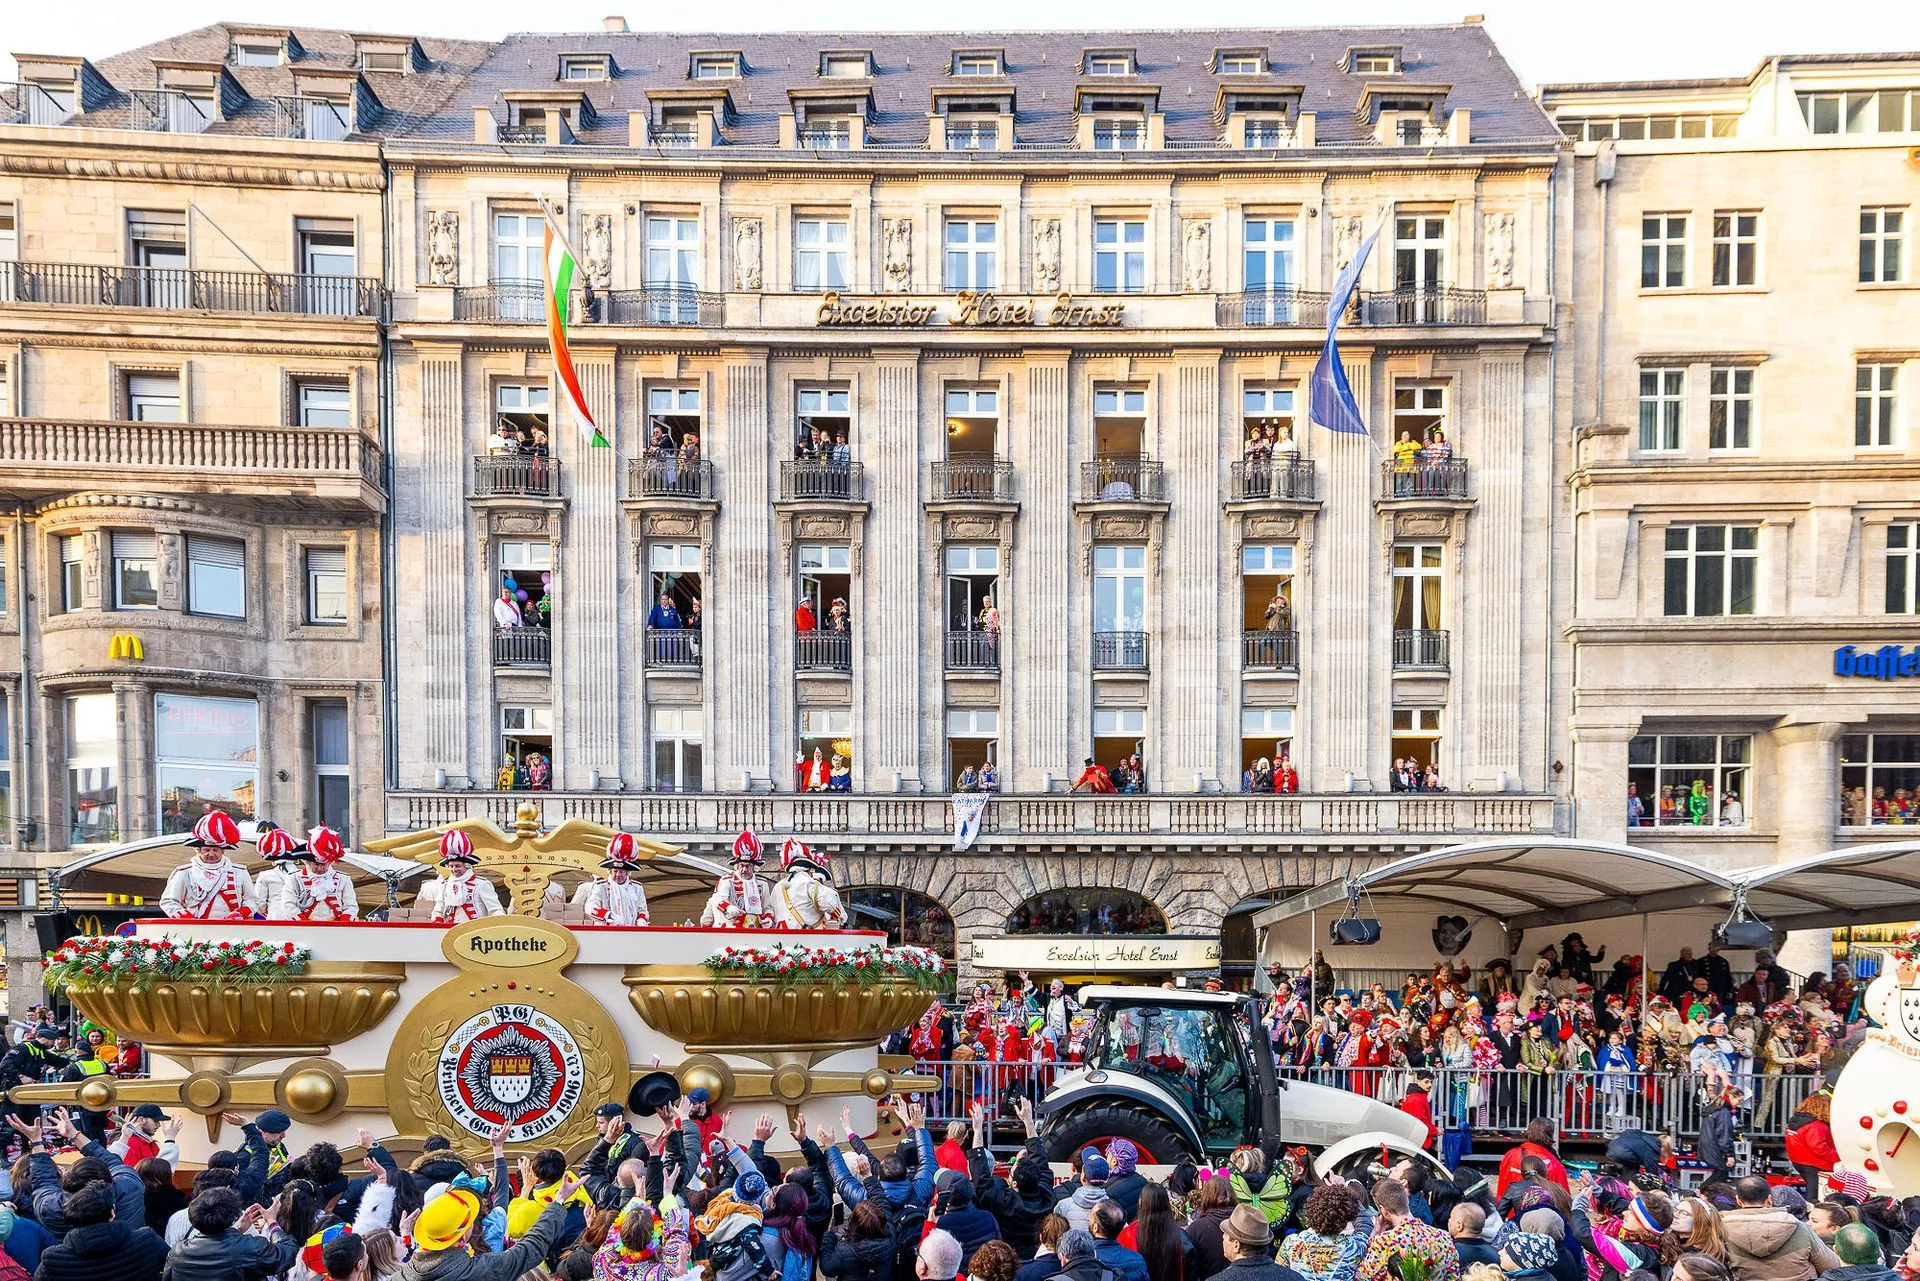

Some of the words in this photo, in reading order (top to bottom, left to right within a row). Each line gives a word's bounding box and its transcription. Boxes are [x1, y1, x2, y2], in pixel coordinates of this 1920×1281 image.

[816, 290, 937, 326] Excelsior
[948, 290, 1036, 326] Hotel
[1047, 292, 1125, 326] Ernst
[470, 935, 548, 954] Apotheke
[1046, 945, 1100, 961] Excelsior
[1105, 943, 1147, 961] Hotel
[1149, 945, 1178, 961] Ernst
[440, 1057, 516, 1139] Prinzen-Gare
[521, 1114, 558, 1138] Köln
[556, 1079, 581, 1117] 1906
